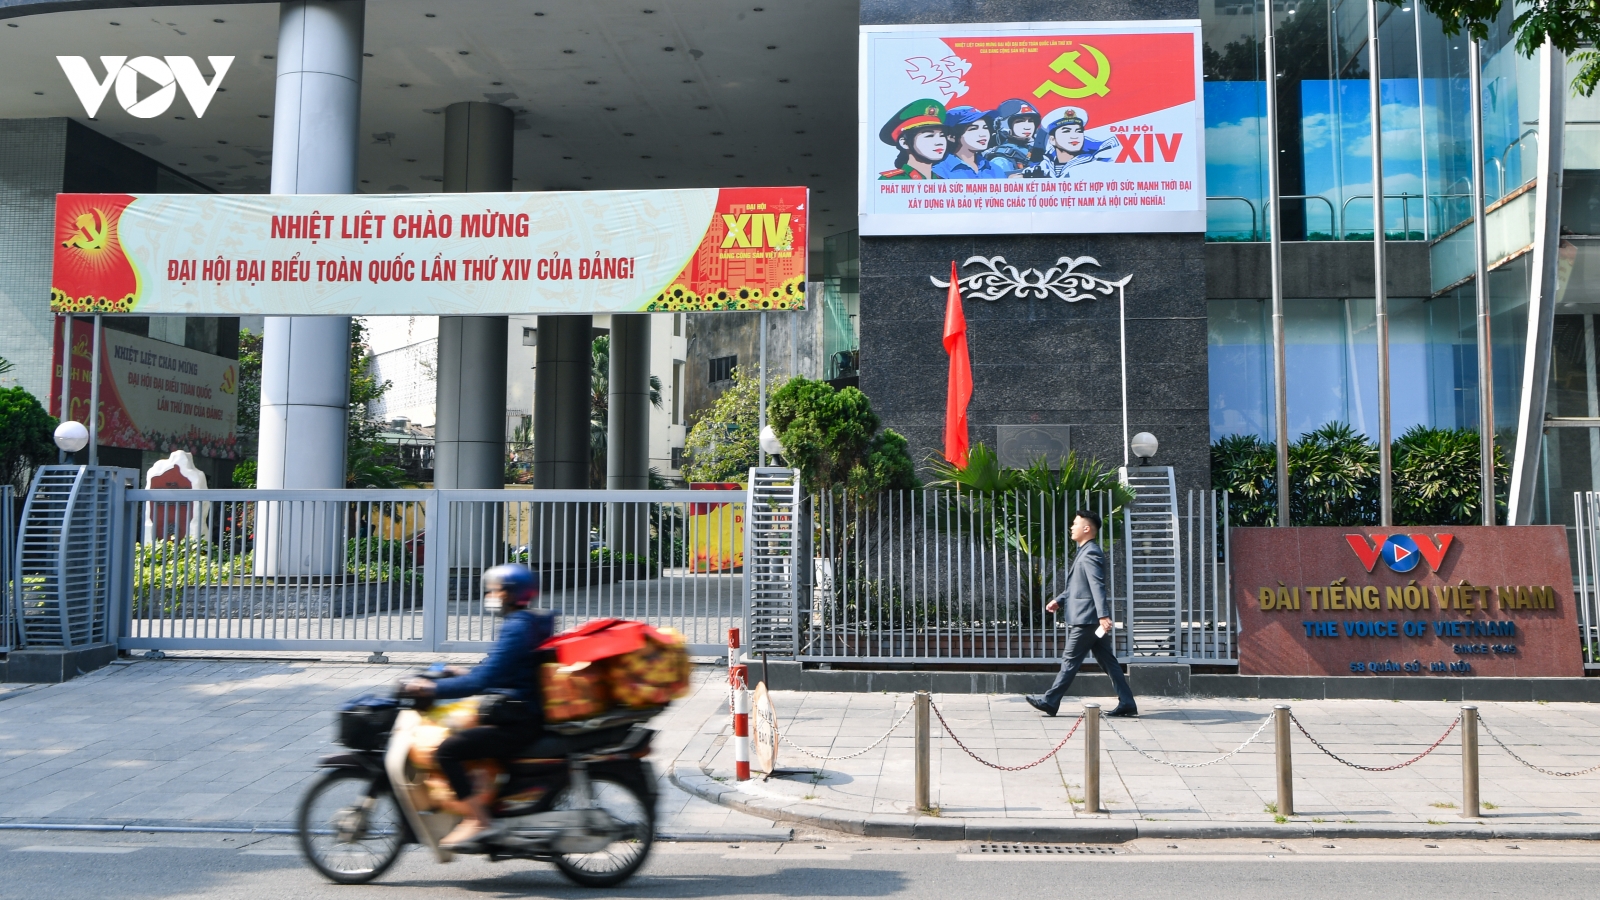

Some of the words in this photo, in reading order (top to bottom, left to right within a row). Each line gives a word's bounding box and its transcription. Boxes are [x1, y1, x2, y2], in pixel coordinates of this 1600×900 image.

[1110, 126, 1129, 134] ĐẠI
[1133, 124, 1153, 133] HỘI
[1114, 133, 1183, 163] XIV
[880, 183, 899, 194] PHÁT
[901, 184, 915, 194] HUY
[917, 183, 922, 193] Ý
[924, 183, 936, 193] CHÍ
[938, 182, 947, 193] VÀ
[949, 182, 963, 193] SỨC
[966, 184, 987, 195] MẠNH
[989, 183, 1001, 194] ĐẠI
[1004, 182, 1024, 192] ĐOÀN
[1026, 180, 1039, 192] KẾT
[1041, 180, 1056, 192] DÂN
[1058, 181, 1072, 194] TỘC
[1074, 179, 1087, 192] KẾT
[1089, 181, 1104, 193] HỢP
[1106, 180, 1118, 191] VỚI
[1120, 179, 1134, 191] SỨC
[1137, 181, 1159, 192] MẠNH
[1161, 179, 1177, 190] THỜI
[1179, 180, 1192, 192] ĐẠI
[908, 198, 922, 208] XÂY
[924, 198, 944, 210] DỰNG
[946, 196, 955, 208] VÀ
[958, 195, 972, 208] BẢO
[974, 197, 983, 210] VỆ
[985, 196, 1004, 208] VỮNG
[1006, 195, 1026, 207] CHẮC
[1028, 194, 1037, 207] TỔ
[1039, 194, 1058, 208] QUỐC
[1060, 196, 1076, 208] VIỆT
[1078, 197, 1095, 207] NAM
[1097, 195, 1107, 206] XÃ
[1109, 195, 1121, 208] HỘI
[1124, 193, 1137, 206] CHỦ
[1140, 195, 1165, 206] NGHĨA!
[270, 210, 334, 244] NHIỆT
[341, 210, 386, 244] LIỆT
[393, 210, 452, 239] CHÀO
[460, 210, 530, 238] MỪNG
[720, 213, 792, 249] XIV
[167, 259, 196, 286] ĐẠI
[202, 256, 230, 286] HỘI
[236, 259, 265, 286] ĐẠI
[272, 252, 310, 282] BIỂU
[317, 256, 362, 282] TOÀN
[368, 253, 415, 284] QUỐC
[421, 252, 457, 282] LẦN
[462, 253, 498, 280] THỨ
[502, 258, 531, 280] XIV
[537, 252, 572, 280] CỦA
[578, 251, 635, 280] ĐẢNG!
[114, 345, 138, 365] NHIỆT
[140, 350, 157, 369] LIỆT
[158, 354, 176, 371] CHÀO
[178, 359, 198, 376] MỪNG
[1345, 534, 1454, 573] VOV
[1259, 580, 1300, 610] ĐÀI
[1306, 576, 1380, 610] TIẾNG
[1387, 580, 1430, 610] NÓI
[1436, 580, 1491, 615] VIỆT
[1496, 585, 1555, 610] NAM
[1303, 621, 1338, 638] THE
[1343, 621, 1398, 637] VOICE
[1403, 621, 1427, 637] OF
[1433, 620, 1515, 637] VIETNAM
[1453, 644, 1488, 654] SINCE
[1491, 644, 1517, 654] 1945
[1350, 662, 1365, 672] 58
[1404, 658, 1422, 672] SỨ
[1430, 659, 1447, 672] HÀ
[1450, 658, 1471, 674] NỘI
